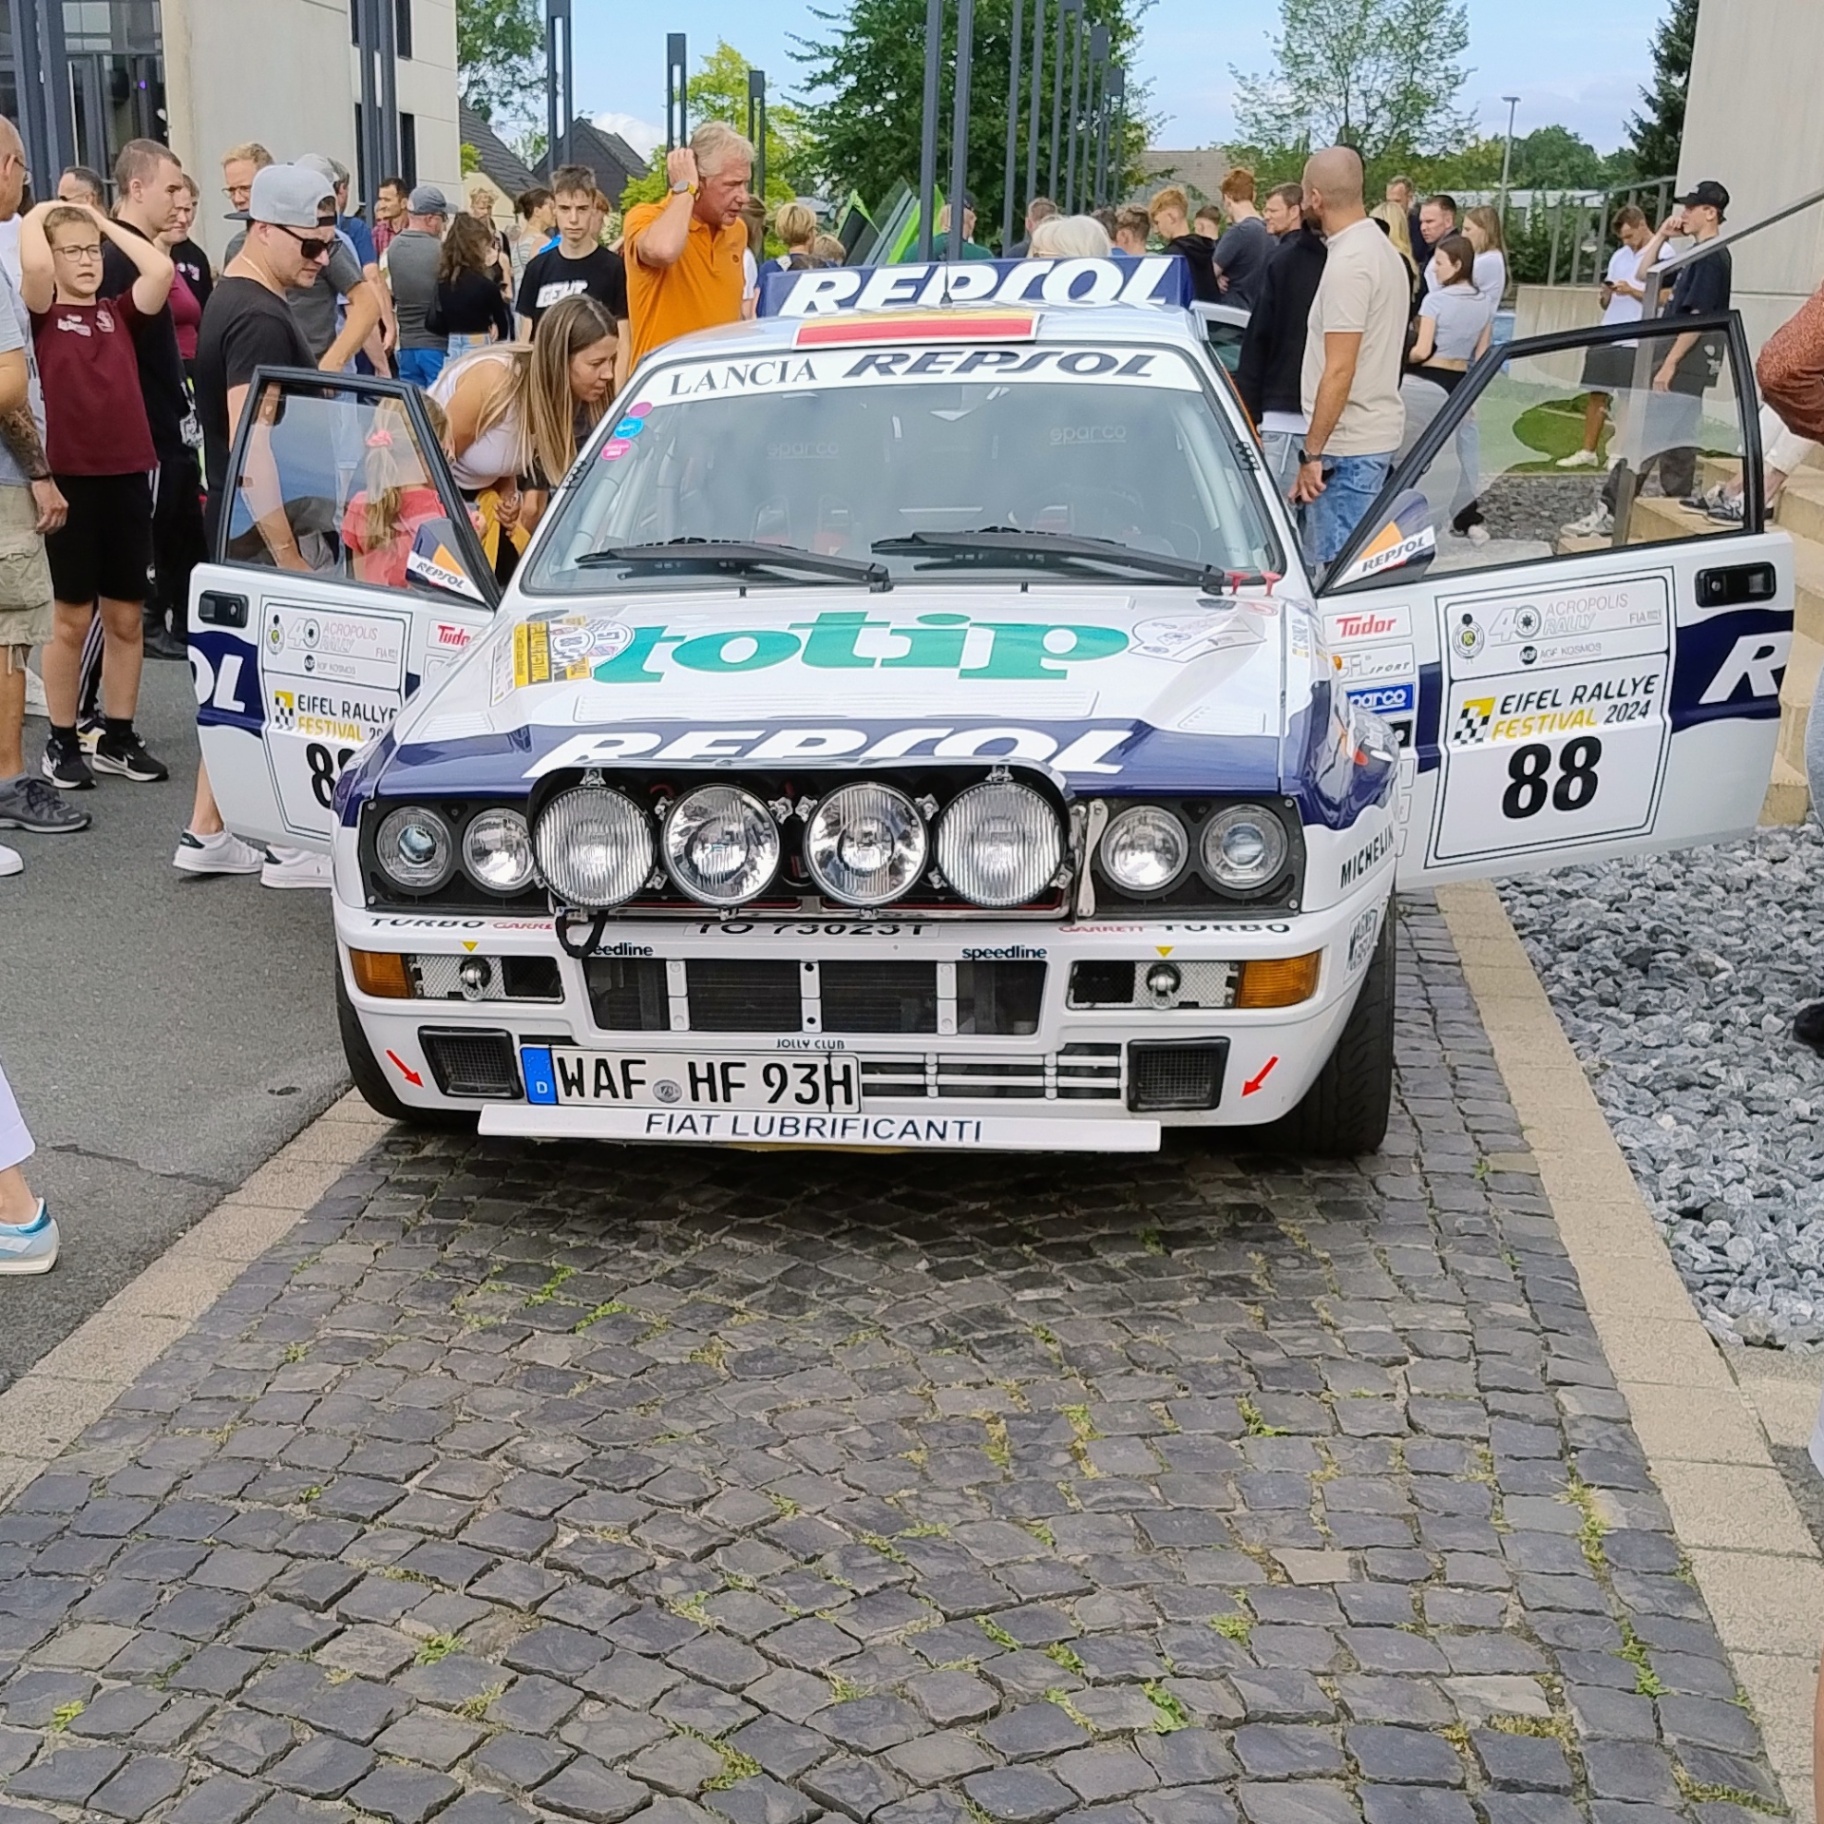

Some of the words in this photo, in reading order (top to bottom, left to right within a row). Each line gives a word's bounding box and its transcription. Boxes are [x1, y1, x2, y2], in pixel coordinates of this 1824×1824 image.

[778, 257, 1174, 317] REPSOL
[842, 350, 1158, 379] REPSOL
[671, 359, 818, 396] LANCIA
[1050, 425, 1127, 444] sparco
[767, 441, 839, 458] sparco
[1362, 536, 1424, 572] REPSOL
[416, 561, 465, 589] REPSOL
[1546, 593, 1629, 616] ACROPOLIS
[1336, 614, 1397, 638] Tudor
[1543, 613, 1597, 636] RALLY
[1629, 611, 1646, 624] FIA
[322, 621, 377, 641] ACROPOLIS
[438, 624, 471, 646] Tudo
[593, 611, 1129, 683] totip
[1561, 643, 1602, 656] KOSMOS
[1369, 662, 1410, 674] SPORT
[1698, 630, 1793, 704] R
[298, 694, 337, 717] EIFEL
[1349, 689, 1407, 708] parco
[1500, 688, 1562, 716] EIFEL
[1569, 674, 1660, 706] RALLYE
[297, 716, 364, 743] FESTIVAL
[1492, 708, 1598, 742] FESTIVAL
[1603, 700, 1651, 725] 2024
[521, 728, 1135, 778] REPSOL
[1502, 736, 1603, 819] 88
[1340, 821, 1394, 889] MICHELIN
[370, 917, 486, 929] TURBO
[772, 922, 933, 936] 73023T
[1058, 924, 1146, 933] GARRETT
[1157, 922, 1291, 934] TURBO
[592, 942, 654, 957] eedline
[962, 944, 1048, 961] speedline
[777, 1038, 811, 1049] JOLLY
[814, 1039, 846, 1050] CLUB
[536, 1081, 548, 1094] D
[557, 1056, 647, 1101] WAF
[688, 1061, 746, 1103] HF
[762, 1062, 854, 1107] 93H
[645, 1113, 720, 1136] FIAT
[731, 1114, 982, 1143] LUBRIFICANTI
